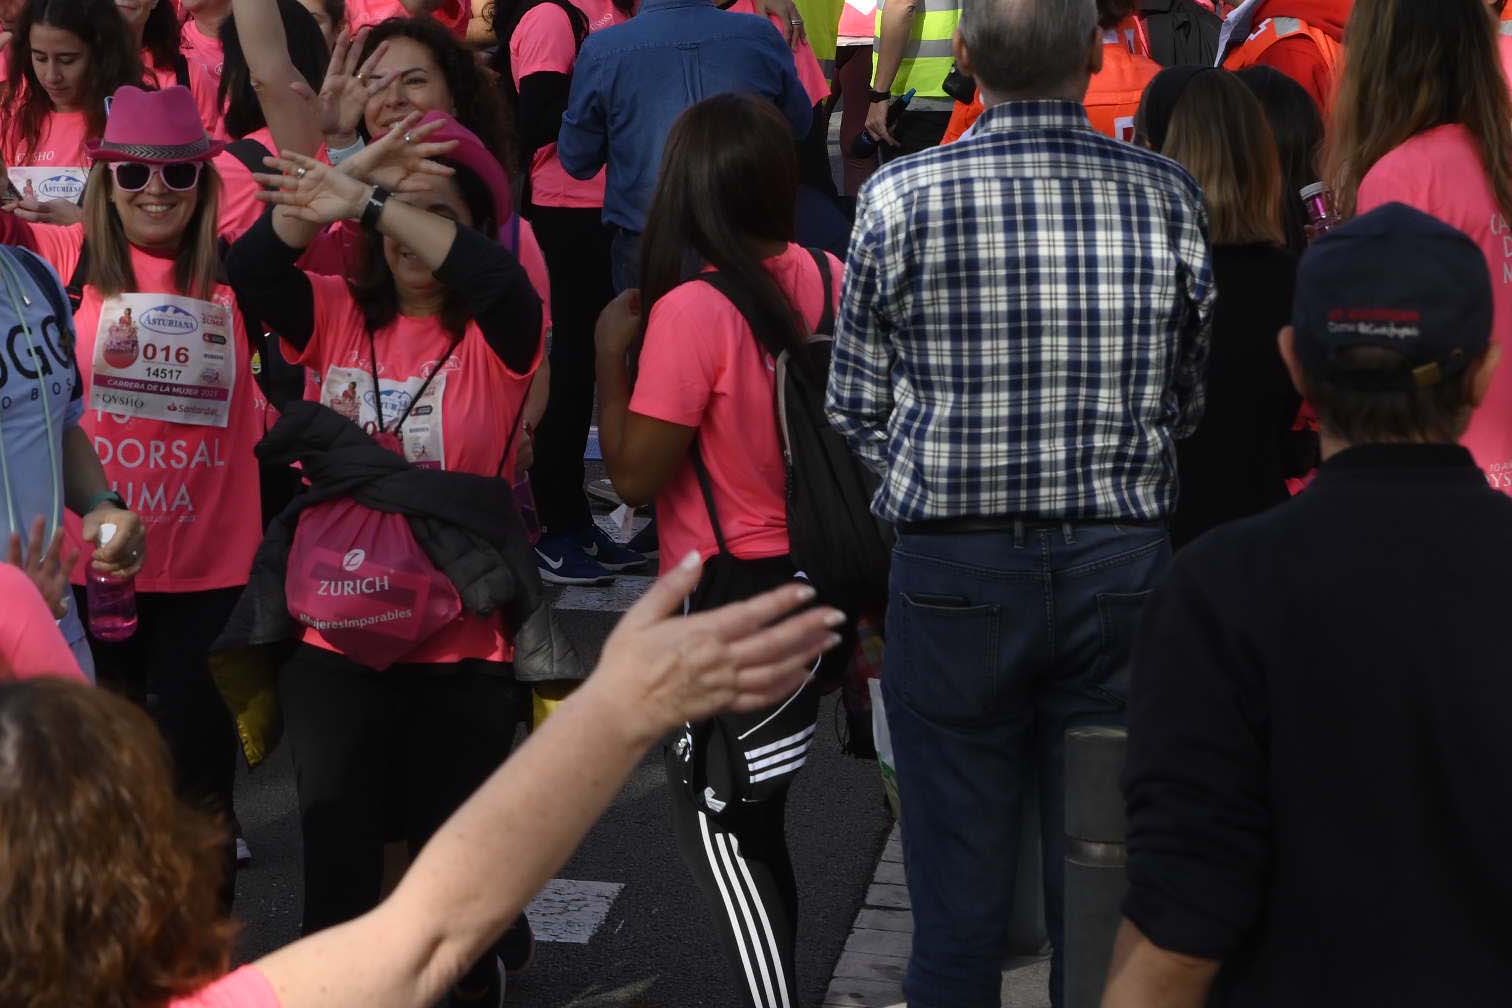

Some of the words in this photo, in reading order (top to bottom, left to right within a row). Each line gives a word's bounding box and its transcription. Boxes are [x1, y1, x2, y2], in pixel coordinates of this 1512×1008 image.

[145, 314, 194, 330] ASTURIANA
[142, 343, 190, 364] 016
[145, 367, 182, 381] 14517
[147, 383, 158, 391] DE
[102, 393, 144, 409] OYSHO
[94, 435, 225, 469] DORSAL
[317, 575, 389, 597] ZURICH
